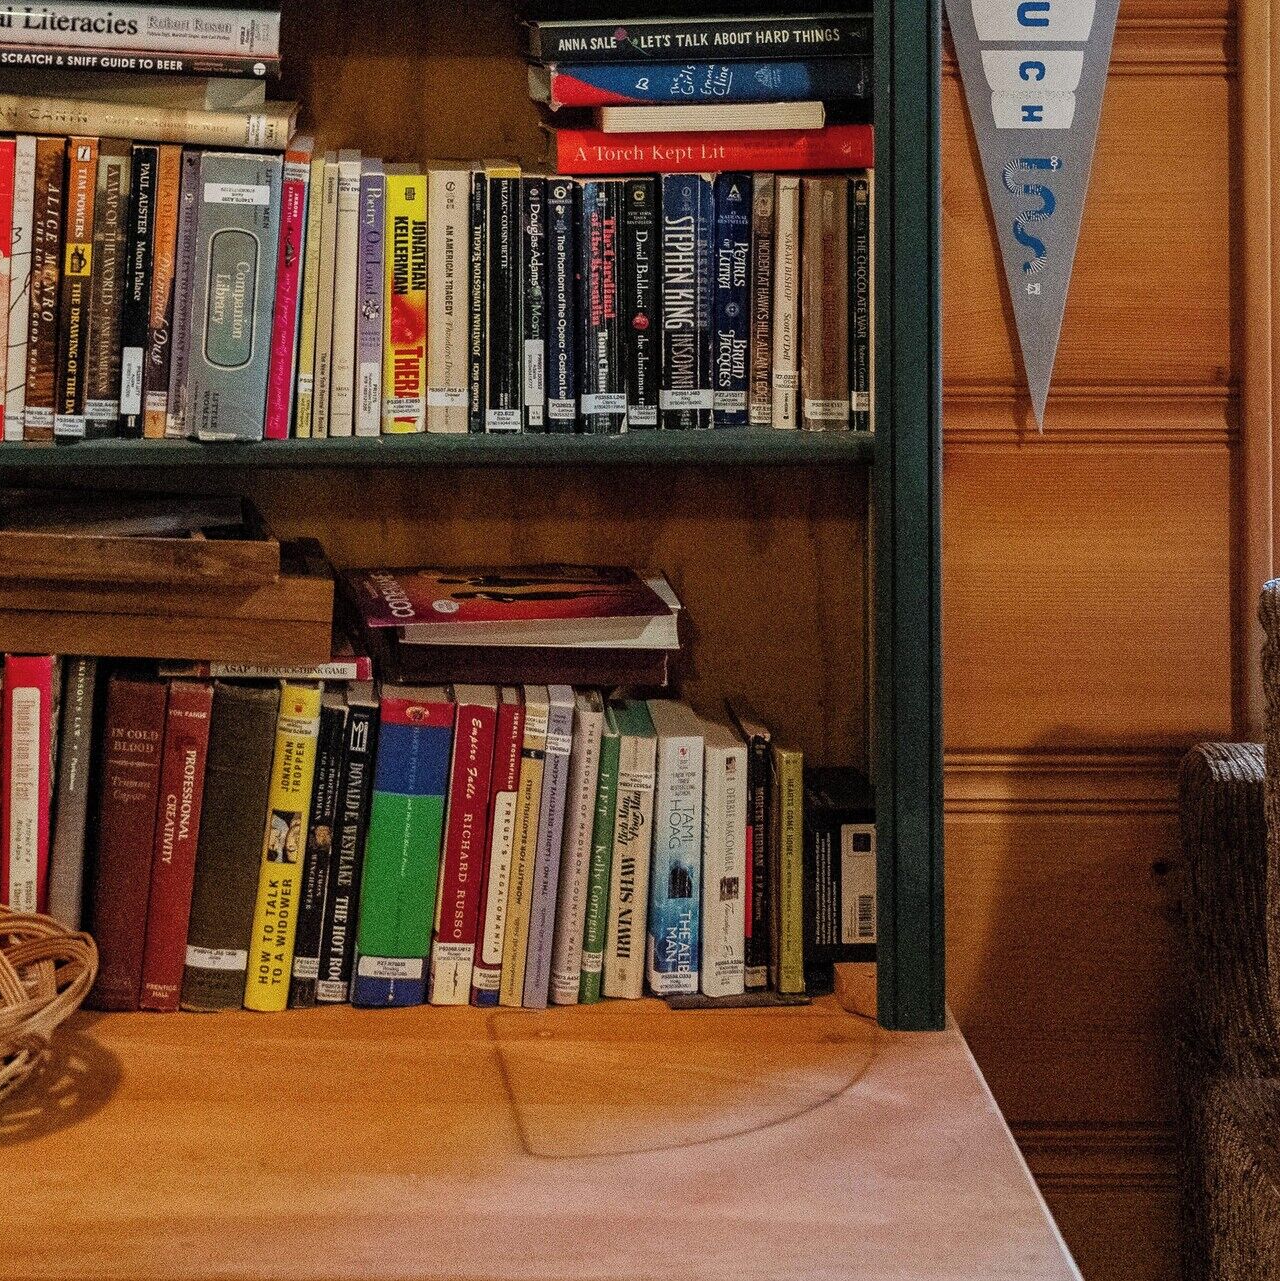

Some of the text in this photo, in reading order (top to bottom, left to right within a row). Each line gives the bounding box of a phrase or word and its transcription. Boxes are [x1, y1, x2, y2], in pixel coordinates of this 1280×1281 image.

[23, 5, 139, 35] Literacies
[558, 29, 840, 51] ANNA SALE LET'S TALK ABOUT HARD THINGS
[2, 52, 51, 65] SCRATCH
[54, 55, 64, 65] &
[67, 55, 98, 67] SNIFF
[102, 56, 137, 69] GUIDE
[140, 58, 154, 70] TO
[157, 59, 183, 70] BEER
[574, 144, 725, 161] A Torch Kept Lit
[133, 162, 150, 301] PAUL AUSTER Moon Palace
[394, 216, 408, 295] KELLERMAN
[411, 220, 427, 292] JONATHAN
[526, 204, 544, 287] Douglas Adams
[214, 273, 232, 323] Library
[232, 261, 249, 339] Companion
[474, 225, 482, 321] LIVINGSTON SEAGULL
[636, 231, 648, 308] David Baldacci
[665, 216, 694, 330] STEPHEN KING
[178, 750, 197, 841] PROFESSIONAL
[280, 740, 294, 792] JONATHAN
[292, 741, 305, 792] TROPPER
[163, 794, 176, 864] CREATIVITY
[456, 813, 473, 882] RICHARD
[278, 877, 292, 944] WIDOWER
[453, 887, 467, 938] RUSSO
[616, 853, 636, 958] IRWIN SHAW
